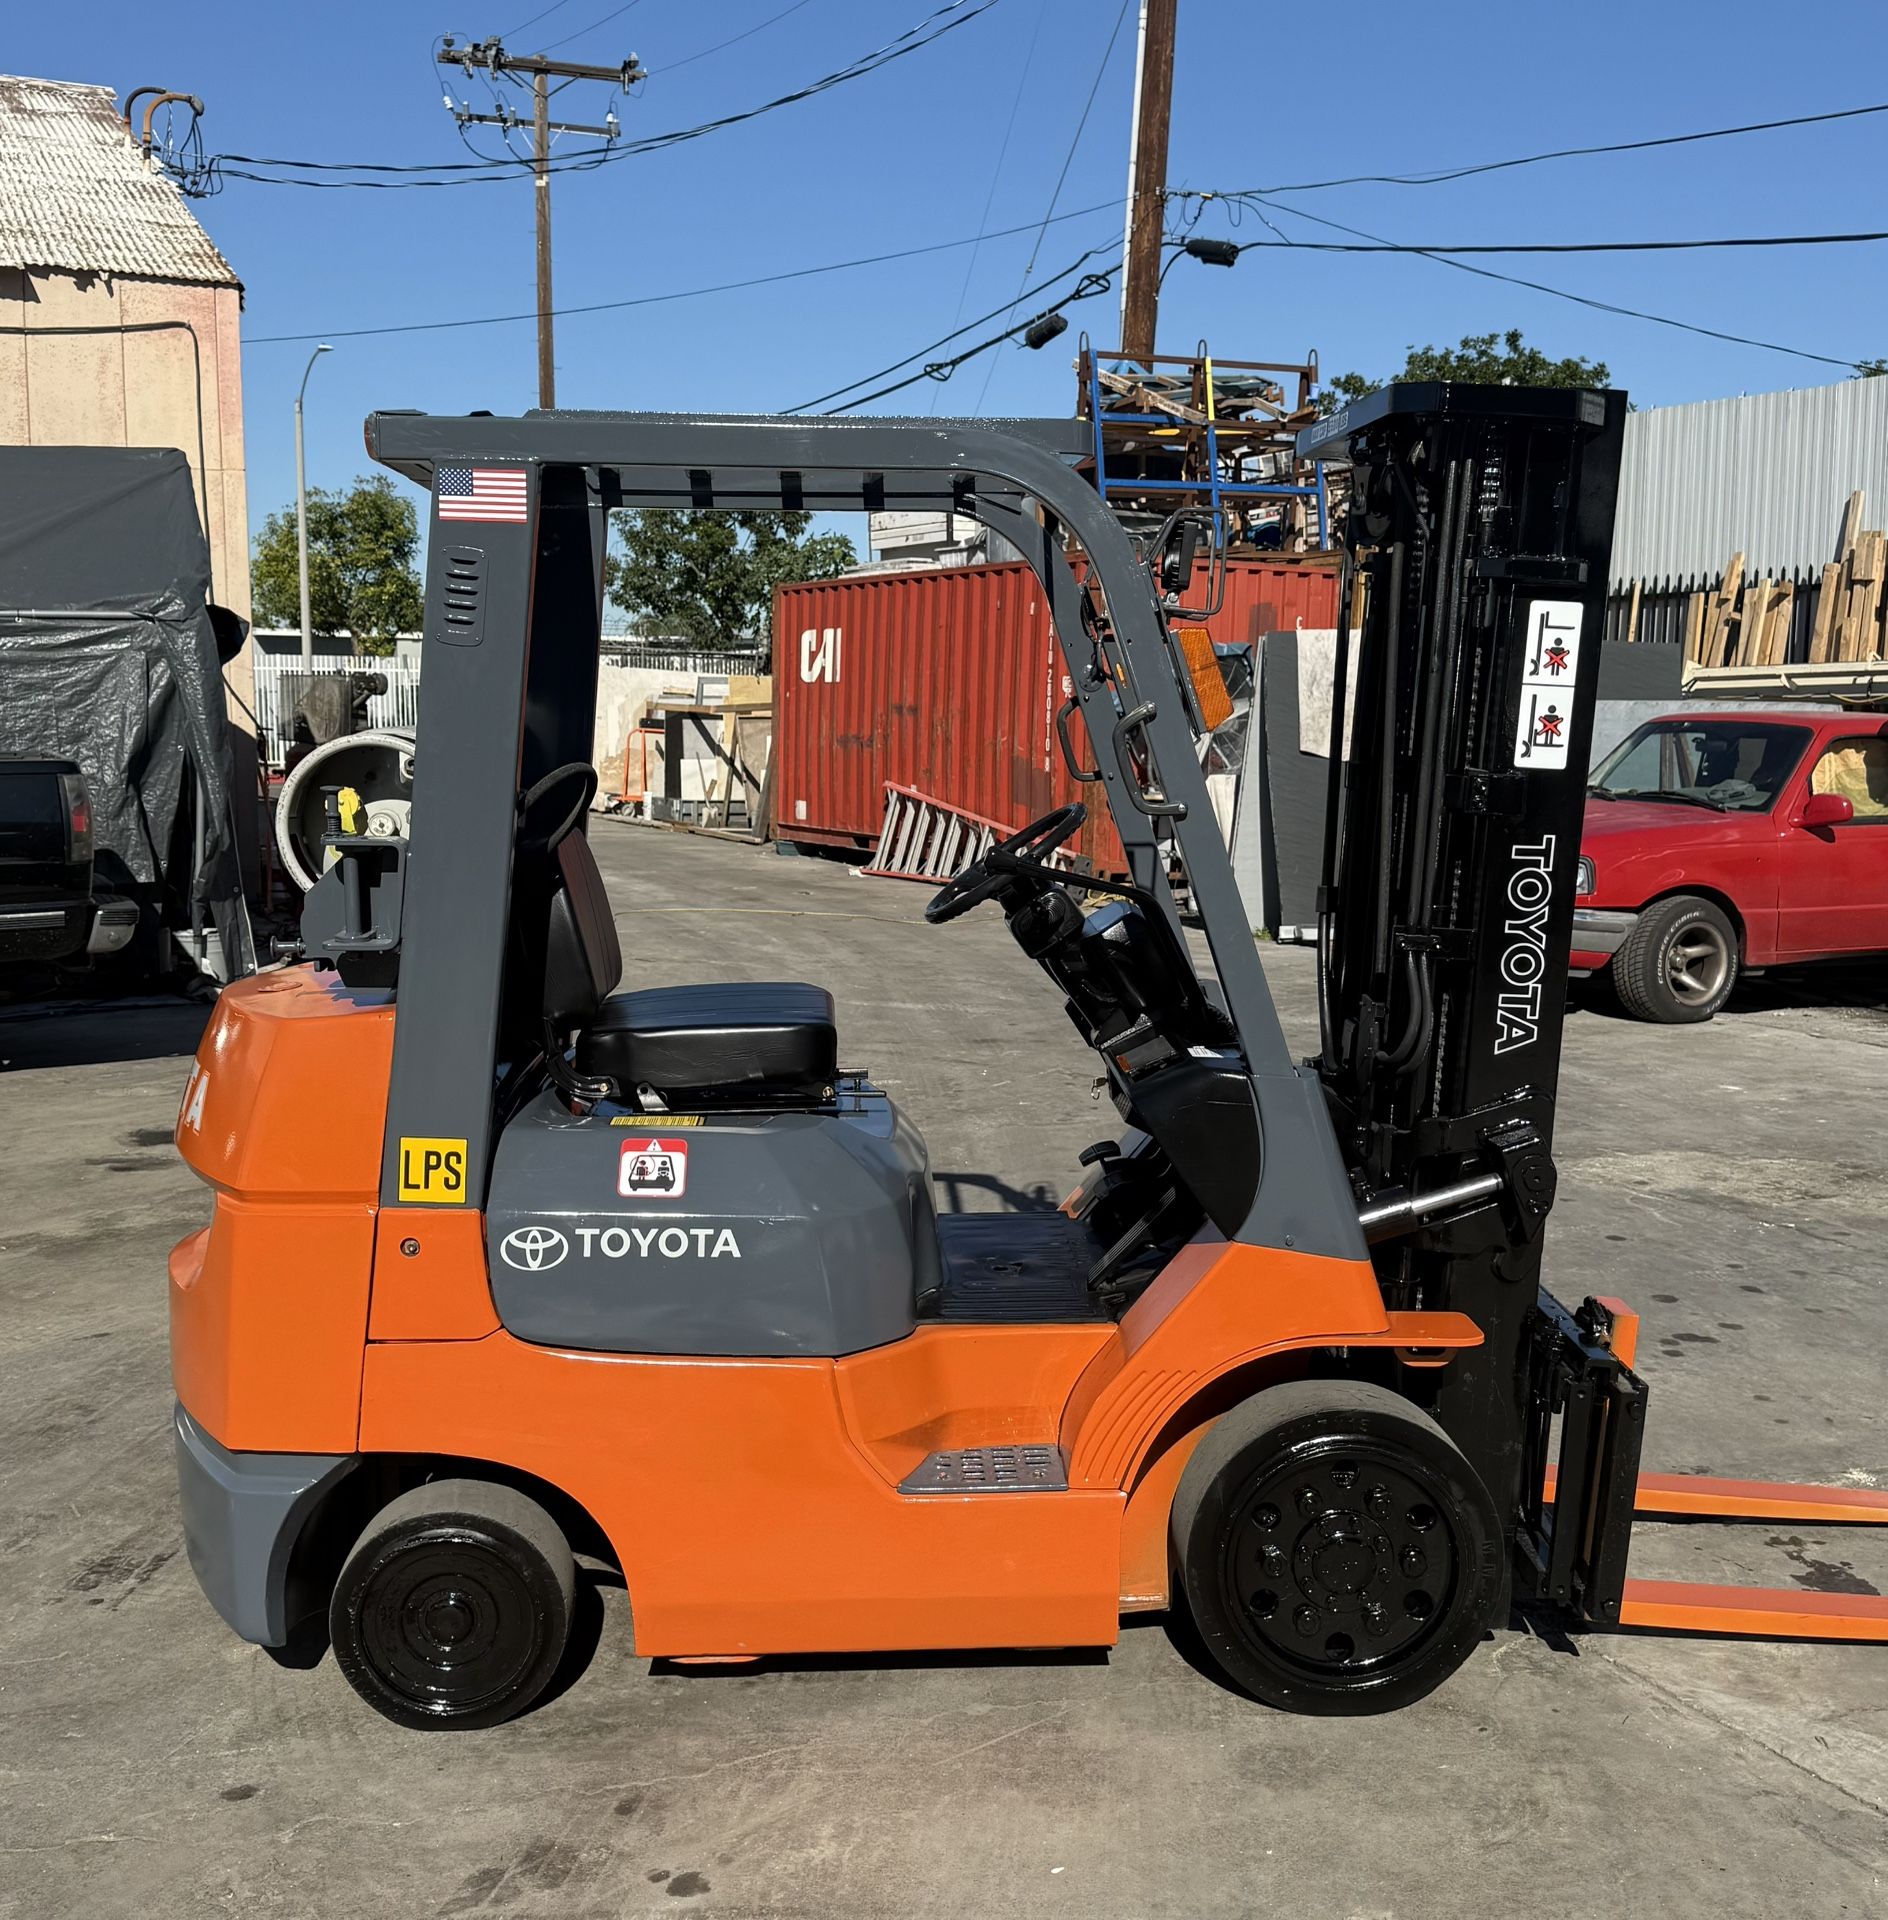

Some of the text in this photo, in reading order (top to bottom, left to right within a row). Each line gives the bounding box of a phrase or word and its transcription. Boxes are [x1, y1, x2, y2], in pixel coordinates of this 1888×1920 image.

[800, 626, 842, 683] CAI
[1494, 834, 1556, 1055] TOYOTA
[1657, 911, 1699, 984] COOPER COBRA
[403, 1150, 462, 1190] LPS
[575, 1227, 742, 1258] TOYOTA
